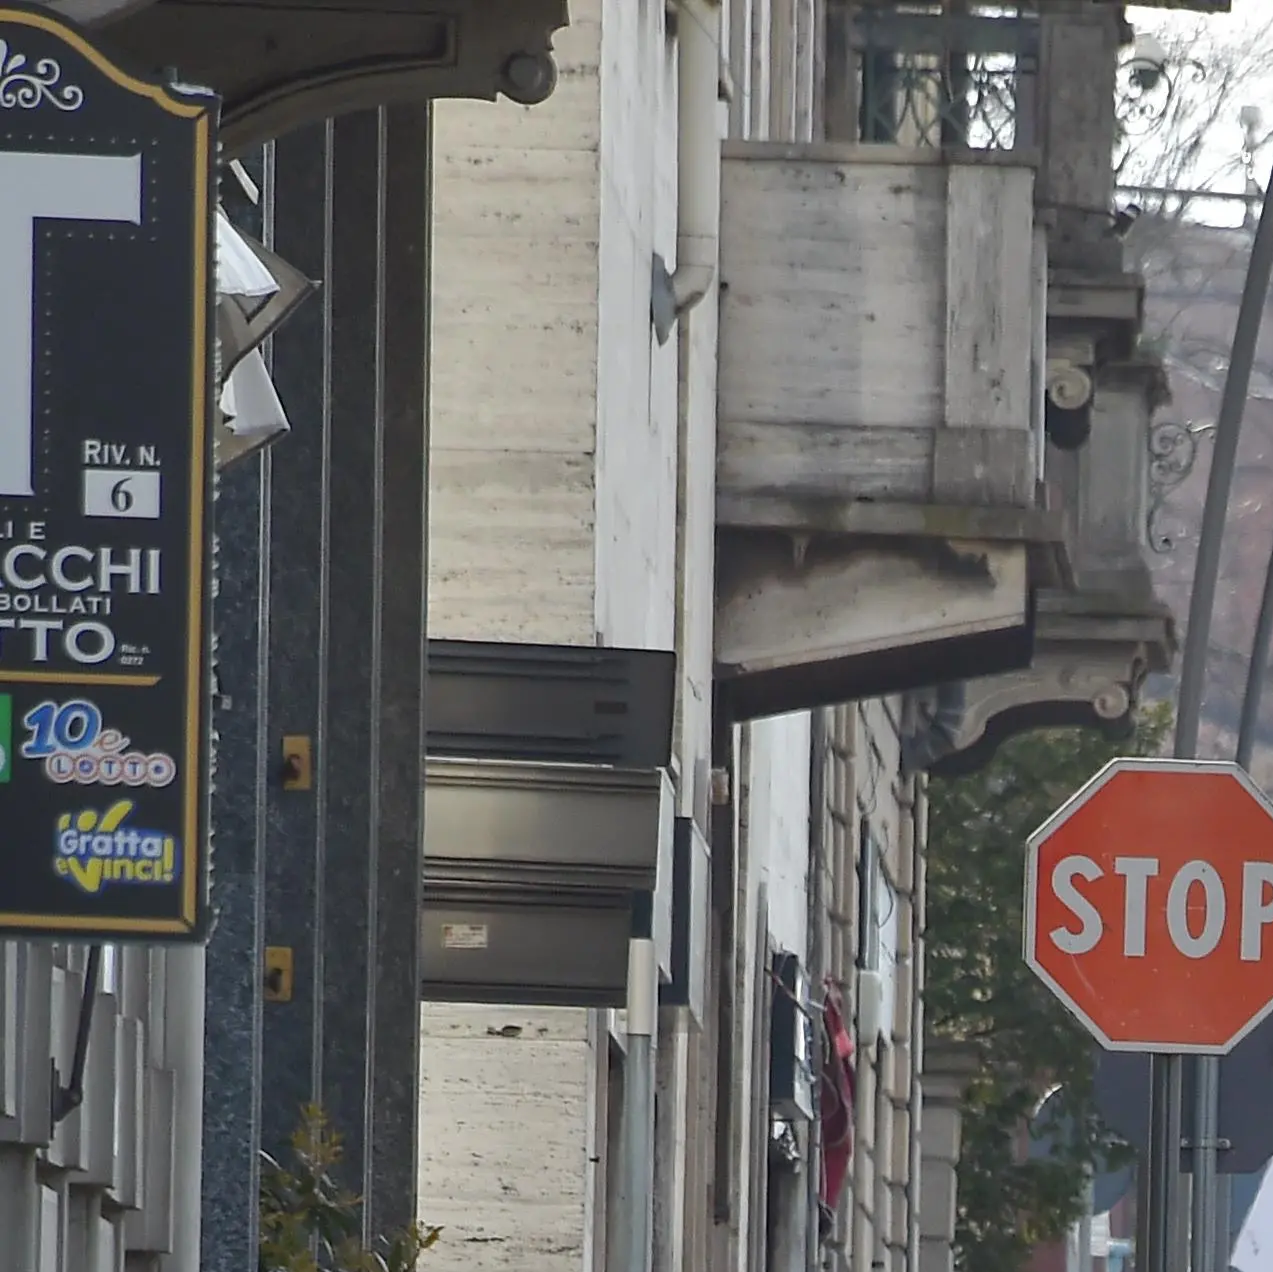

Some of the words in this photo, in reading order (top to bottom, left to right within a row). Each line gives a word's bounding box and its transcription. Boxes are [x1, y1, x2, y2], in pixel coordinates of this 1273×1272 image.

[138, 446, 161, 466] N.
[111, 476, 133, 512] 6
[29, 521, 46, 540] E
[0, 544, 161, 594] CCHI
[22, 700, 102, 757] 10
[51, 754, 172, 783] LOTTO
[59, 828, 163, 857] Gratta
